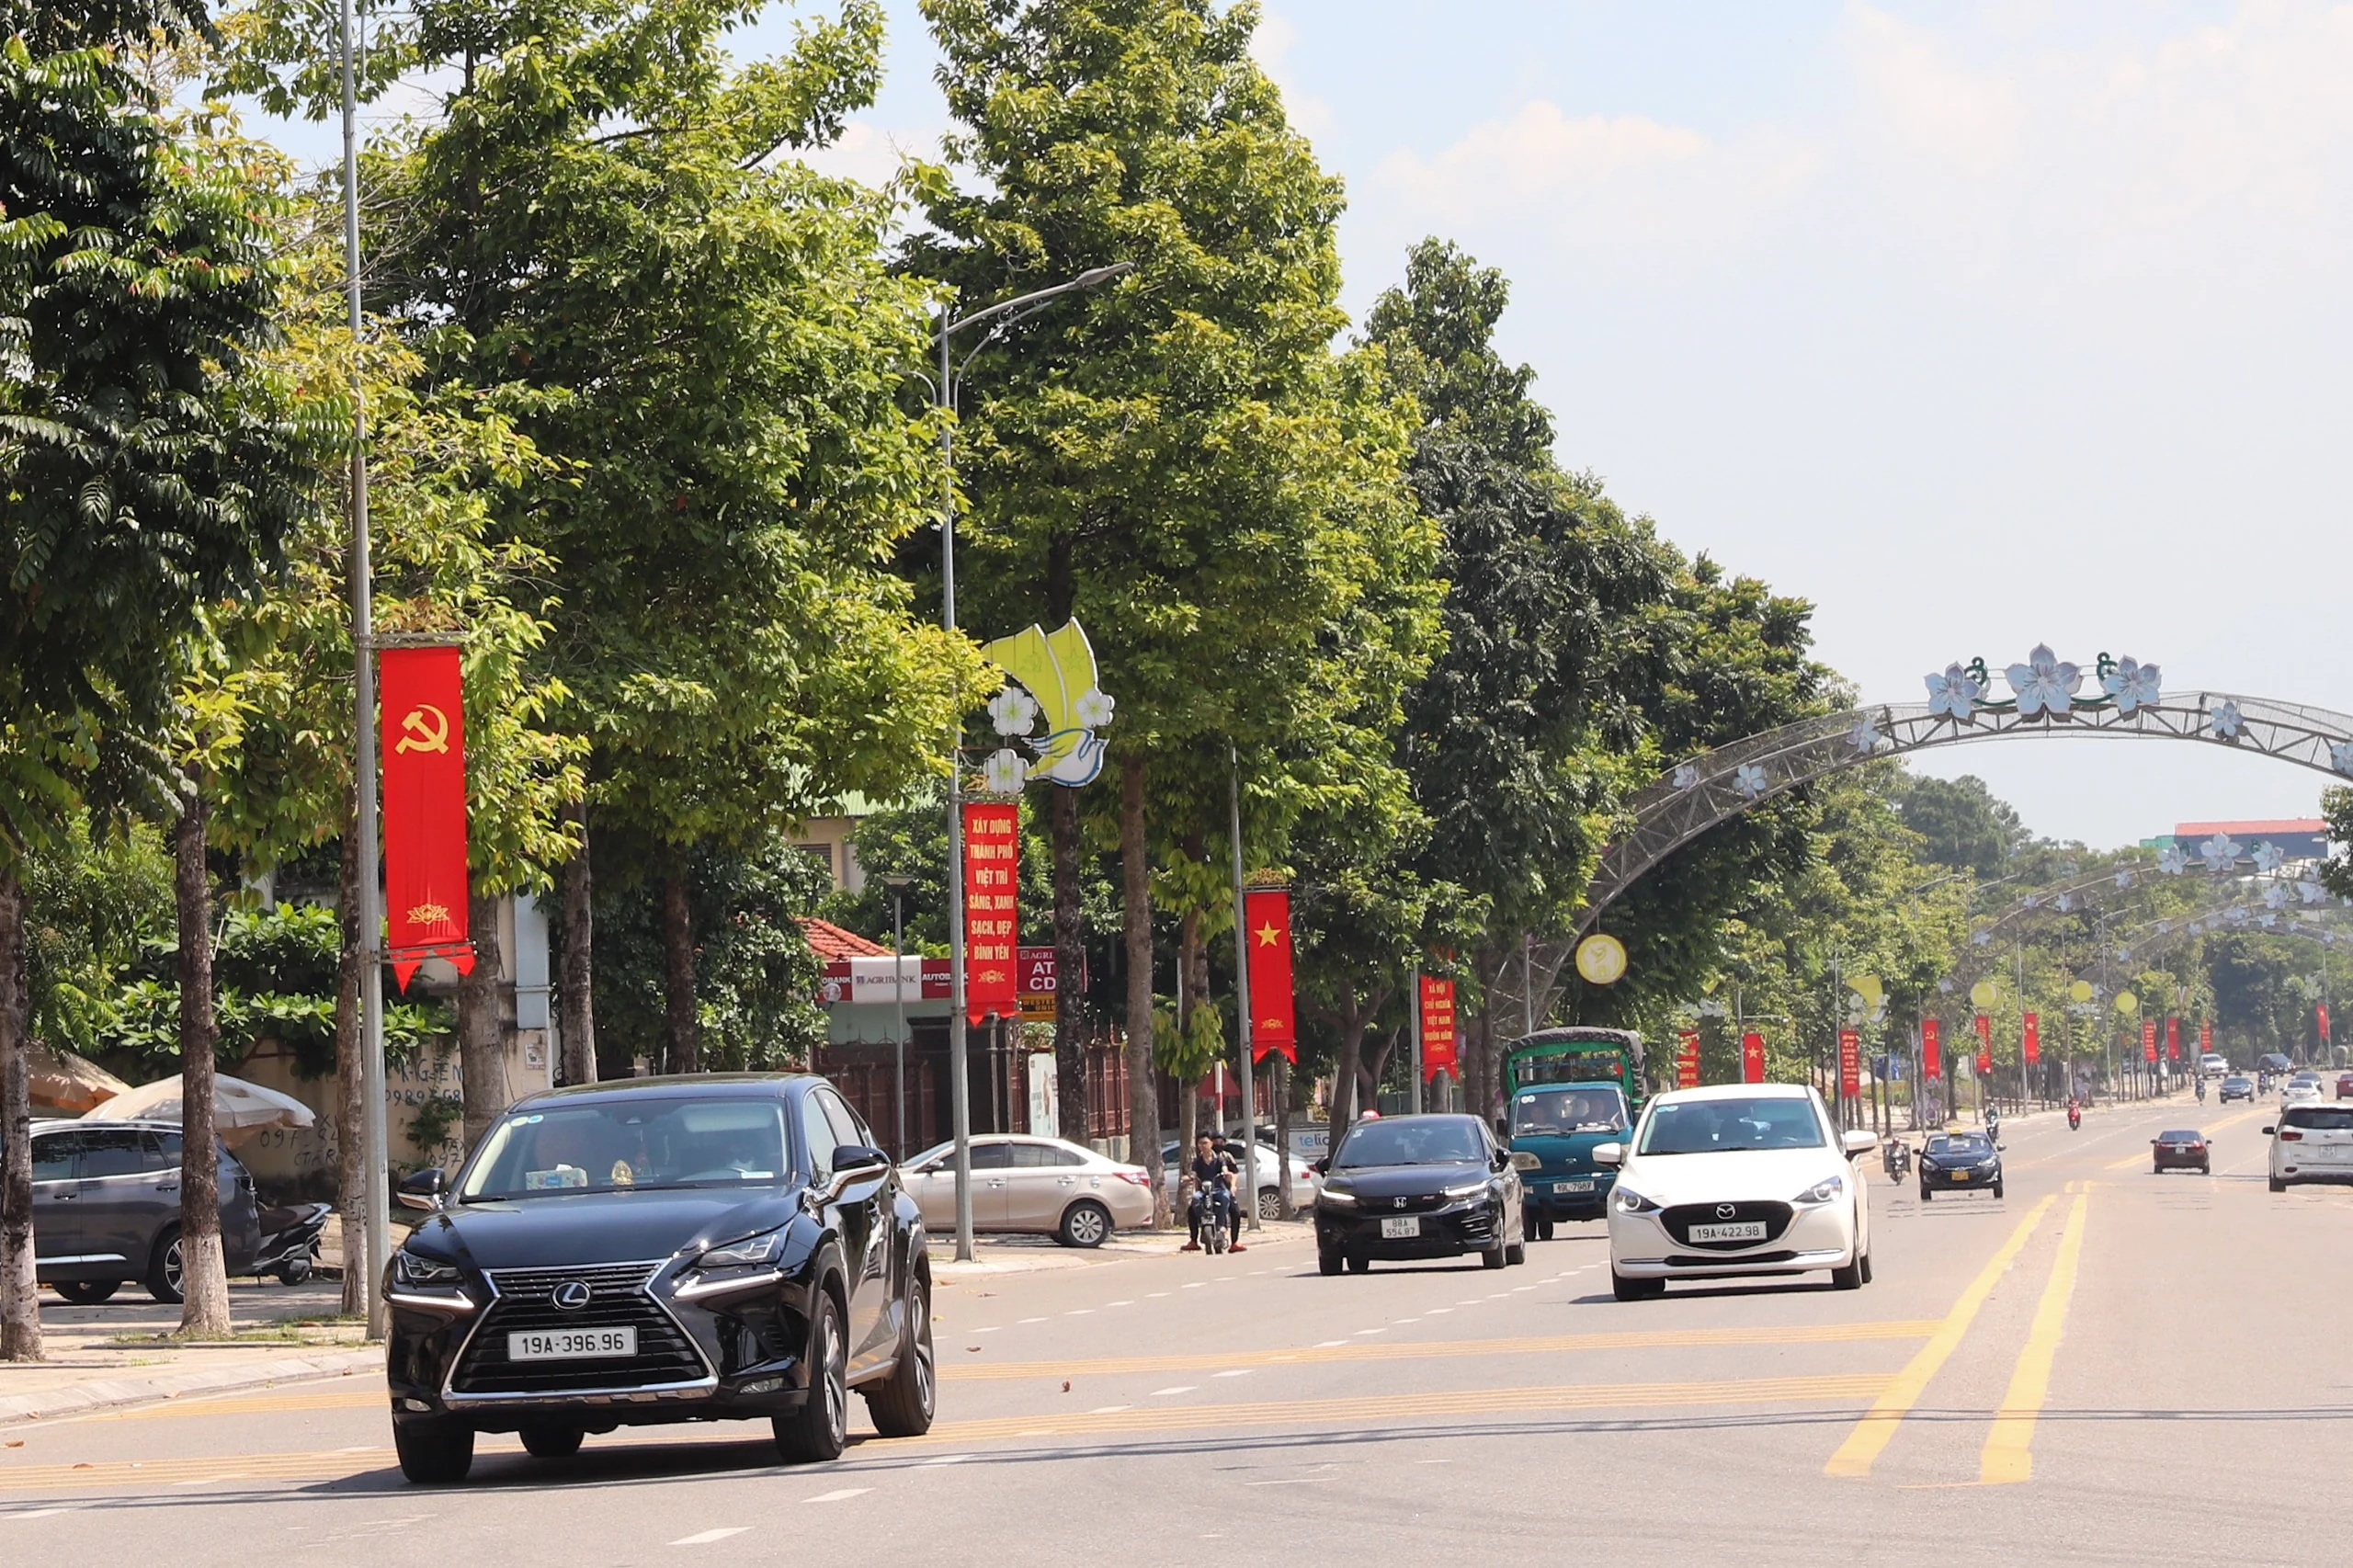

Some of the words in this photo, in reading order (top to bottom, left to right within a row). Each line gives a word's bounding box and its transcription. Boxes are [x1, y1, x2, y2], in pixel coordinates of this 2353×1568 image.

[990, 818, 1011, 837] DỰNG
[997, 839, 1013, 859] PHỐ
[975, 867, 993, 888] VIỆT
[995, 867, 1007, 885] TRÌ
[969, 892, 993, 911] SÁNG,
[995, 895, 1014, 910] XANH
[972, 920, 995, 937] SẠCH,
[997, 920, 1012, 937] ĐẸP
[974, 942, 993, 960] BÌNH
[995, 942, 1009, 960] YÊN
[1032, 961, 1055, 974] AT
[822, 976, 851, 984] OBANK
[922, 971, 969, 982] AUTOBK
[1029, 976, 1056, 991] CD
[1697, 1225, 1759, 1239] 19A-422.98
[522, 1333, 624, 1354] 19A-396.96
